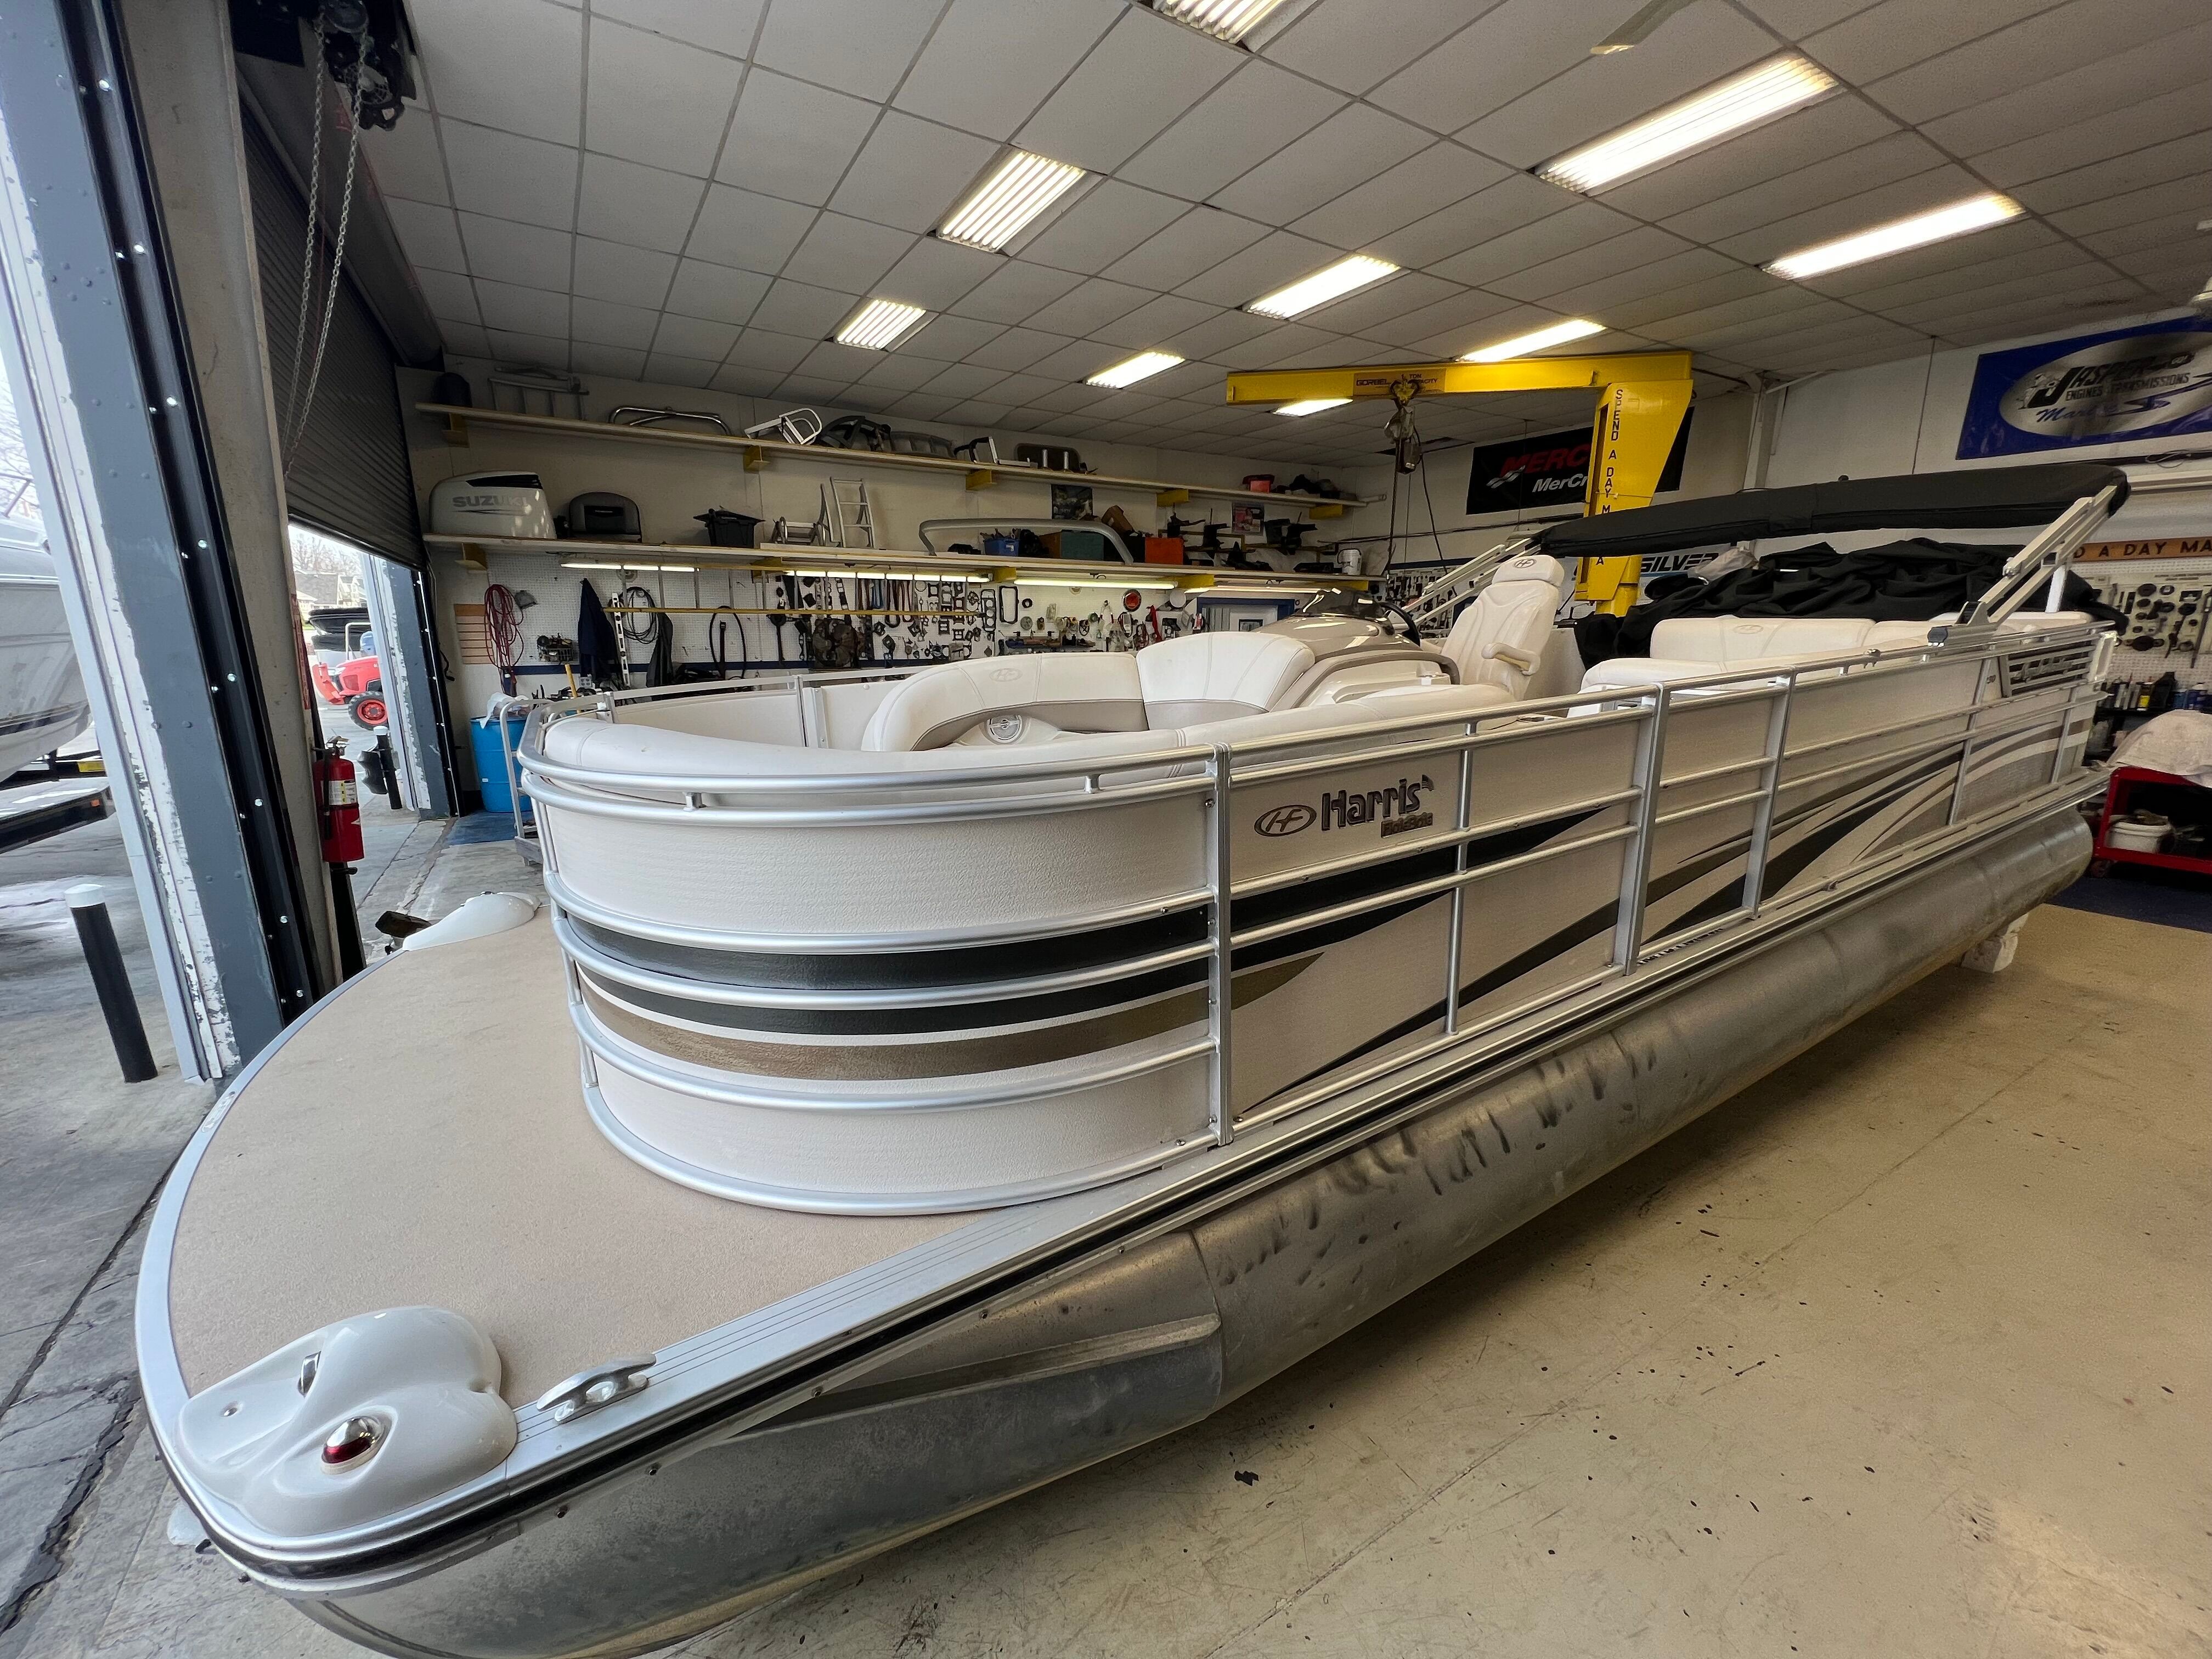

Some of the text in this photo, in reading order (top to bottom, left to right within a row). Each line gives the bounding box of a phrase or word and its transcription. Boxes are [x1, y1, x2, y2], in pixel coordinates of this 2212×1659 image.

[2066, 386, 2103, 401] ENGINES
[1604, 389, 1623, 498] SPEND A DAY
[1500, 443, 1590, 477] MERC
[1532, 473, 1588, 493] MerCr
[453, 495, 527, 507] SUZUKI
[2098, 545, 2109, 557] A
[2124, 541, 2166, 556] DAY
[1640, 552, 1719, 572] SILVER
[1321, 778, 1421, 831] Harris
